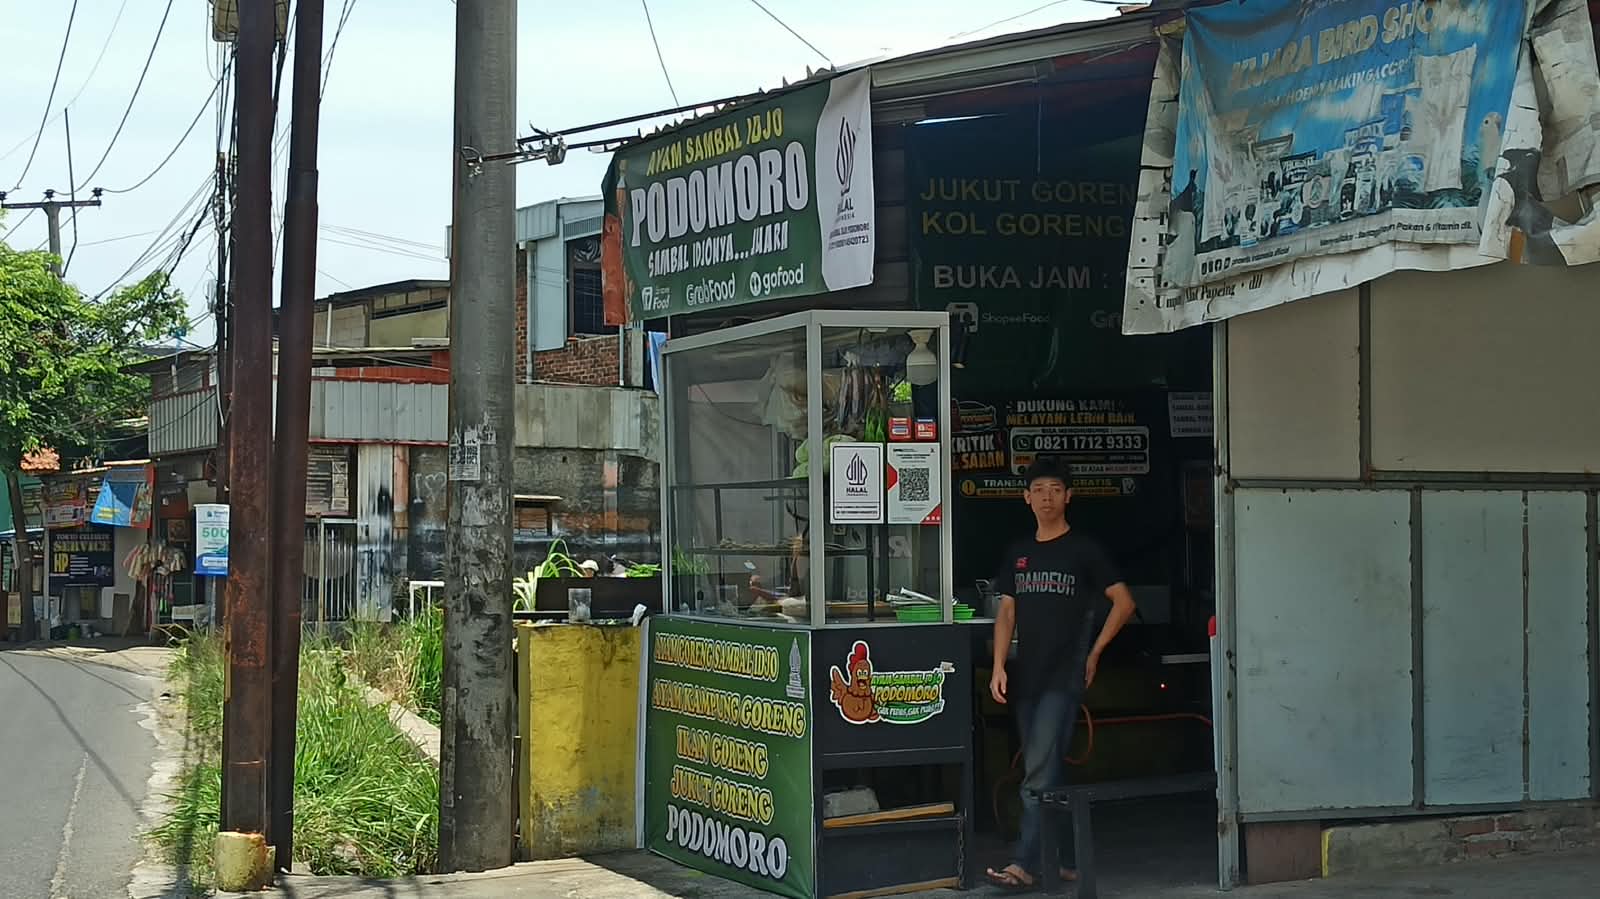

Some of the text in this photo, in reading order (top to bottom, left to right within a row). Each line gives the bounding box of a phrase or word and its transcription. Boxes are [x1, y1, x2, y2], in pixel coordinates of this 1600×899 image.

[1317, 14, 1378, 65] BIRD
[646, 107, 784, 176] AYAM SAMBAL IDJO
[631, 141, 809, 247] PODOMORO
[920, 177, 1138, 207] JUKUT GOREN
[922, 211, 1125, 238] KOL GORENG
[648, 244, 689, 278] SAMBAL
[933, 265, 1021, 289] BUKA
[1029, 265, 1091, 289] JAM
[686, 272, 736, 306] GrabFood
[763, 263, 804, 296] gofood
[1016, 400, 1075, 413] DUKUNG
[1033, 435, 1142, 450] 0821 1712 9333
[54, 552, 69, 573] HP
[713, 639, 753, 679] SAMBAL
[752, 645, 780, 682] IDJO
[653, 678, 806, 738] AYAM KAMPUNG GORENG
[874, 685, 939, 702] PODOMORO
[676, 725, 769, 780] IKAN GORENG
[671, 764, 774, 825] JUKUT GORENG
[665, 804, 788, 879] PODOMORO
